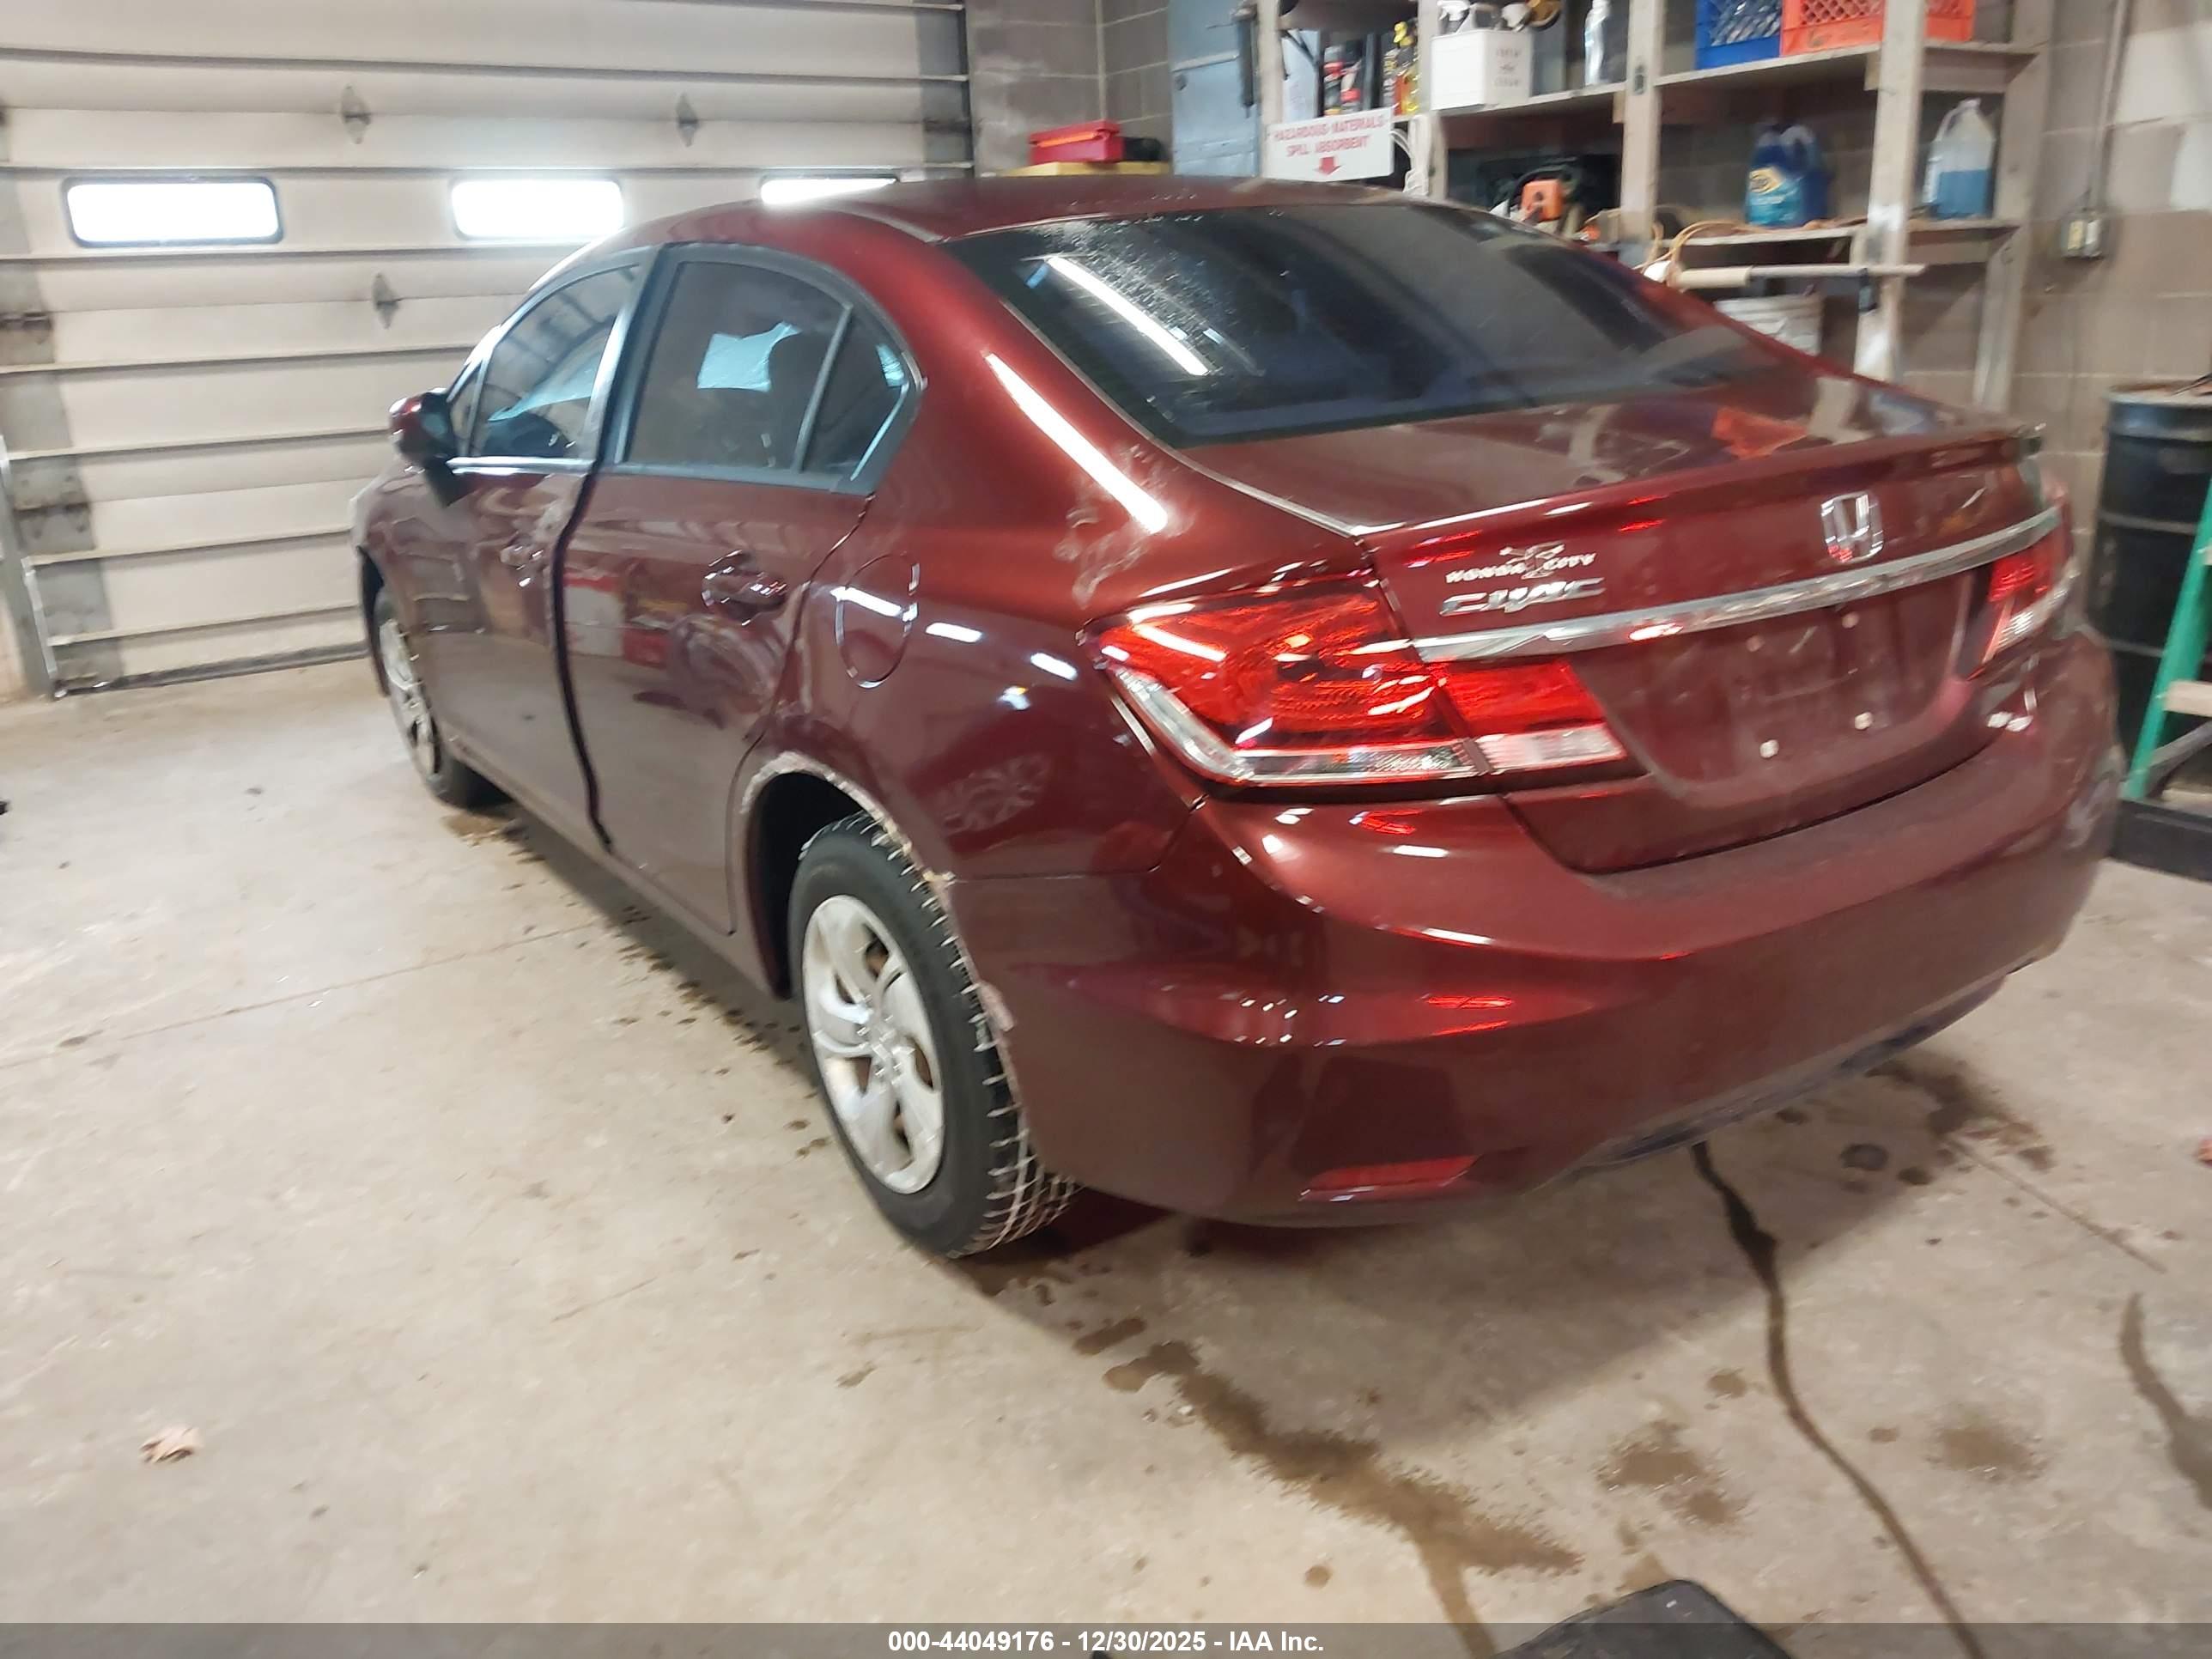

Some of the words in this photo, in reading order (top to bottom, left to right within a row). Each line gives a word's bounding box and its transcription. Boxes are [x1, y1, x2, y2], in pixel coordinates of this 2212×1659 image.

[1331, 113, 1386, 135] MATERIALS
[1315, 135, 1371, 155] ABSORBENT
[1438, 577, 1607, 617] CIVIC
